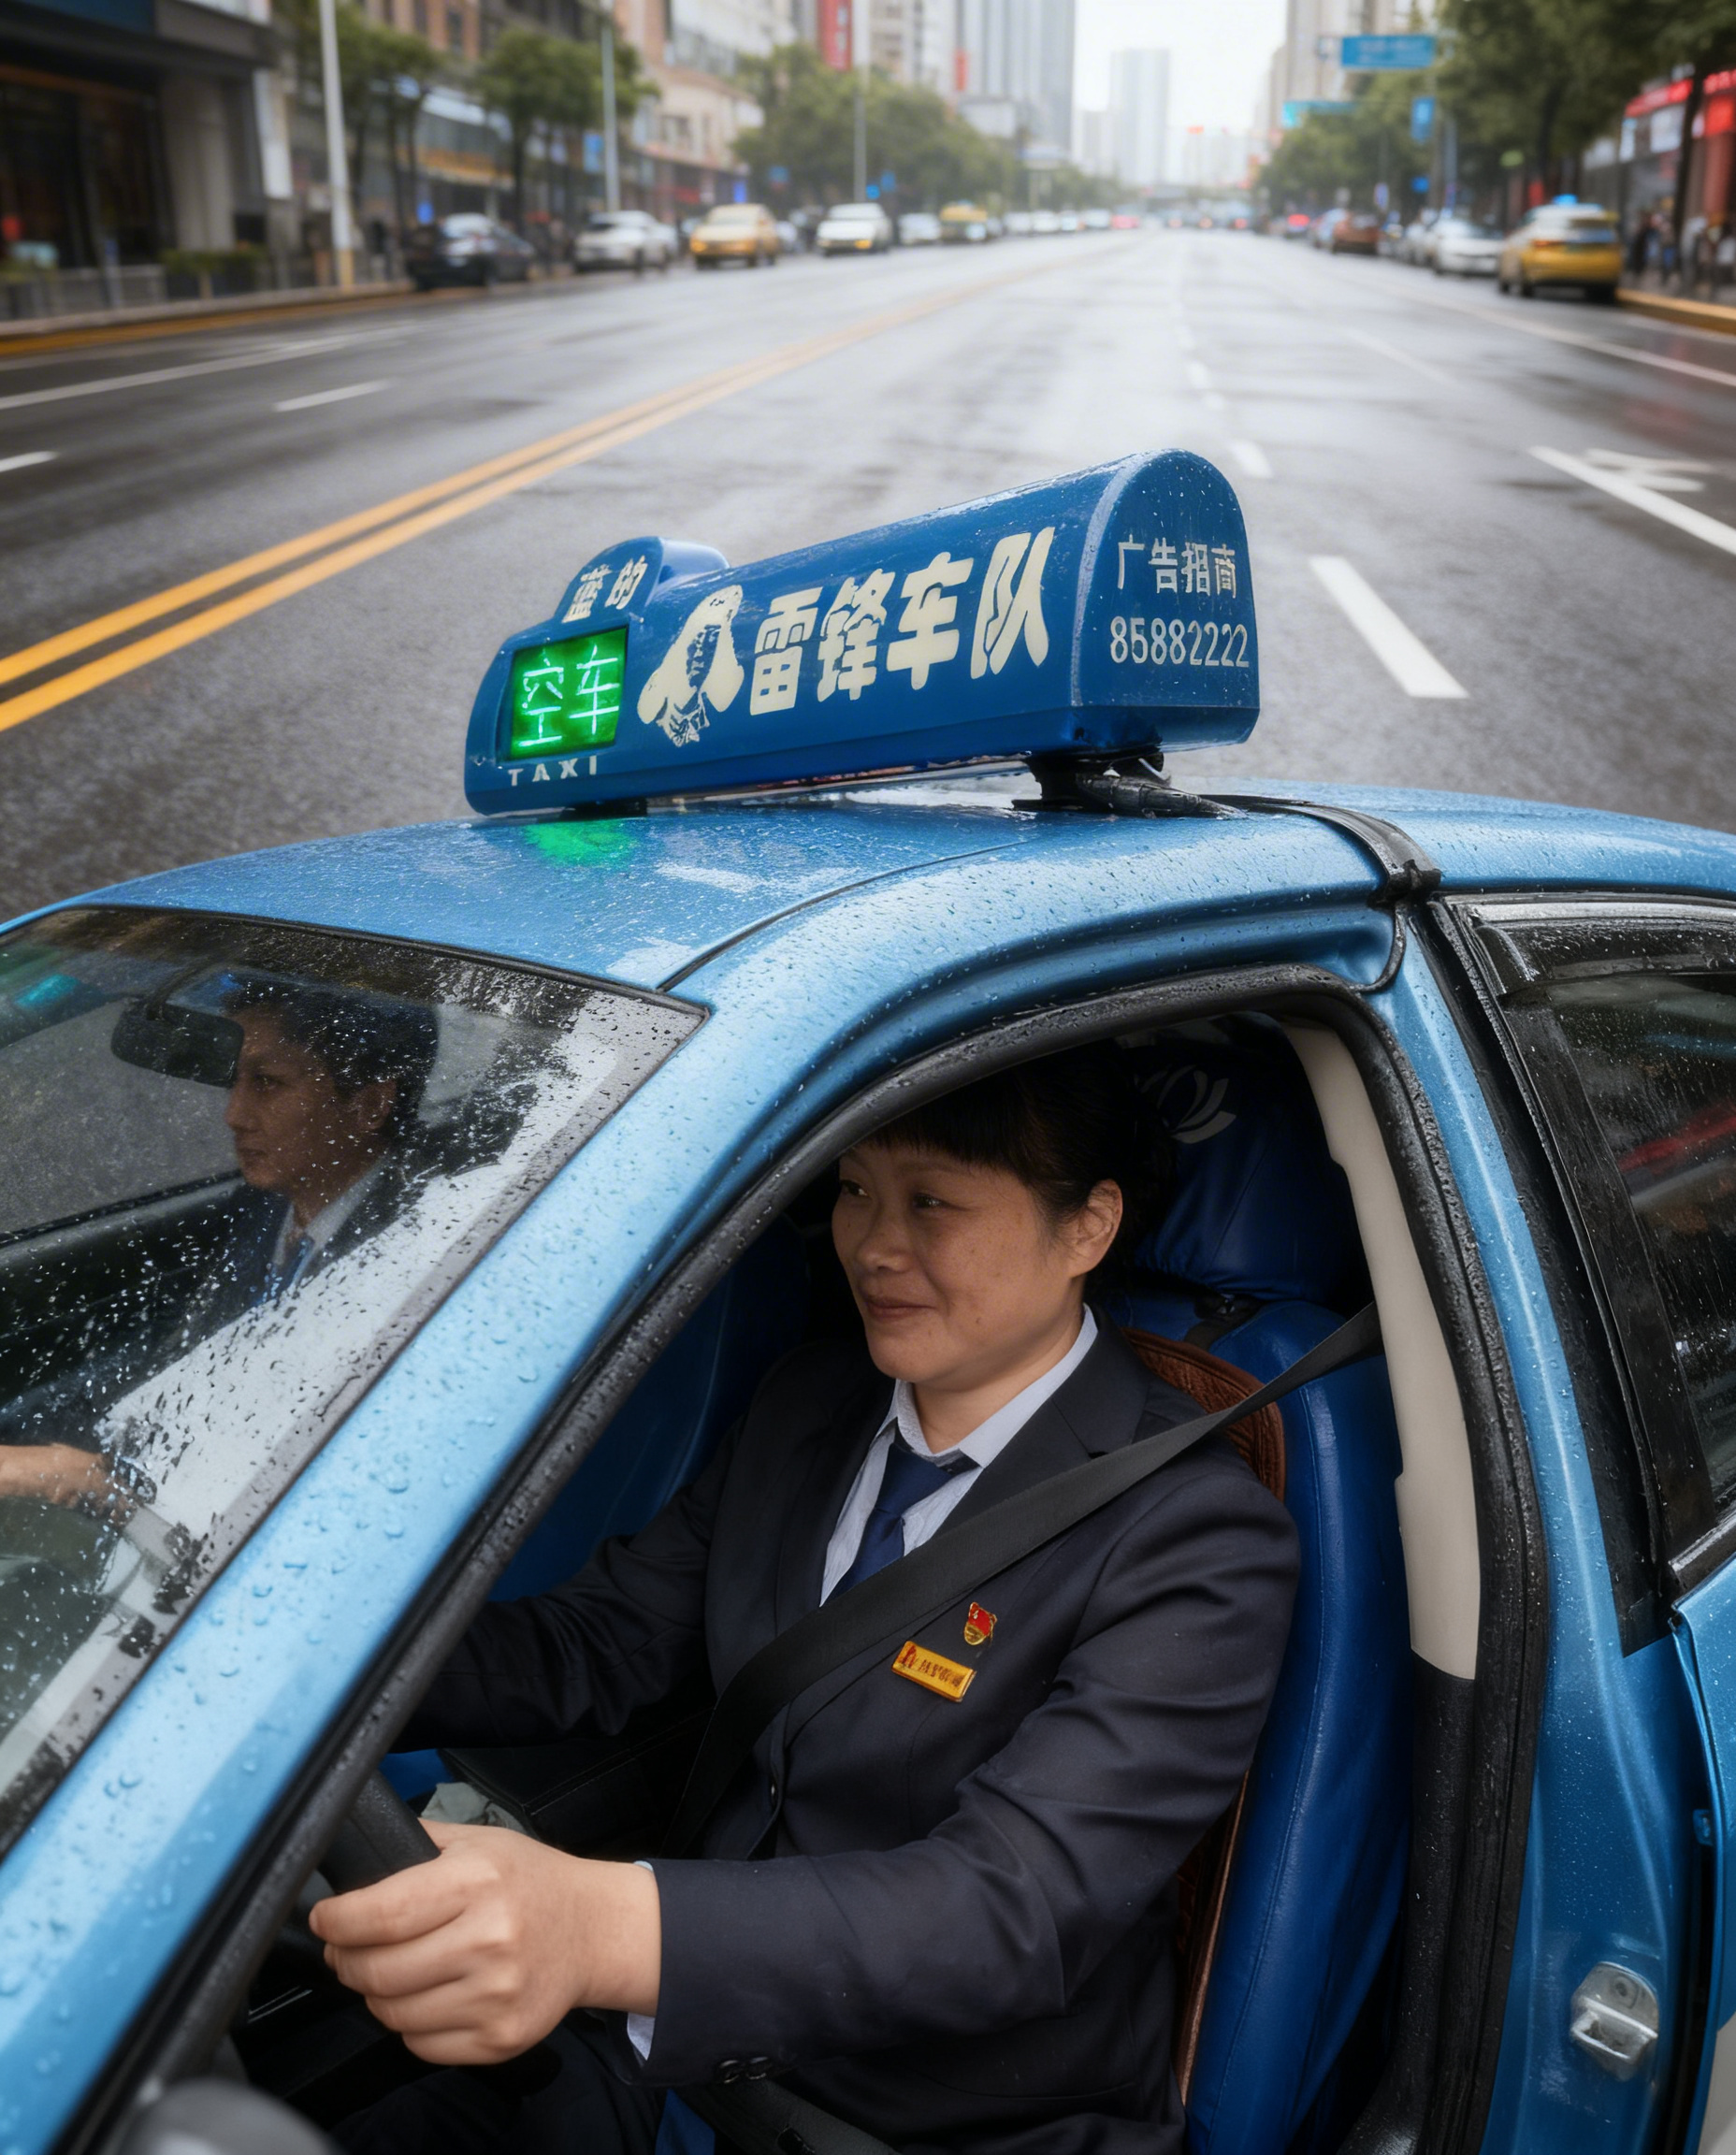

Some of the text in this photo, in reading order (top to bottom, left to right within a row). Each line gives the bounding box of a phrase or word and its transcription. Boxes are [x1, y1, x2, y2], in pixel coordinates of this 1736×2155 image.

[750, 527, 1056, 716] 雷锋车队
[1110, 615, 1250, 668] 85882222
[517, 644, 621, 747] 空车
[508, 755, 598, 787] TAXI
